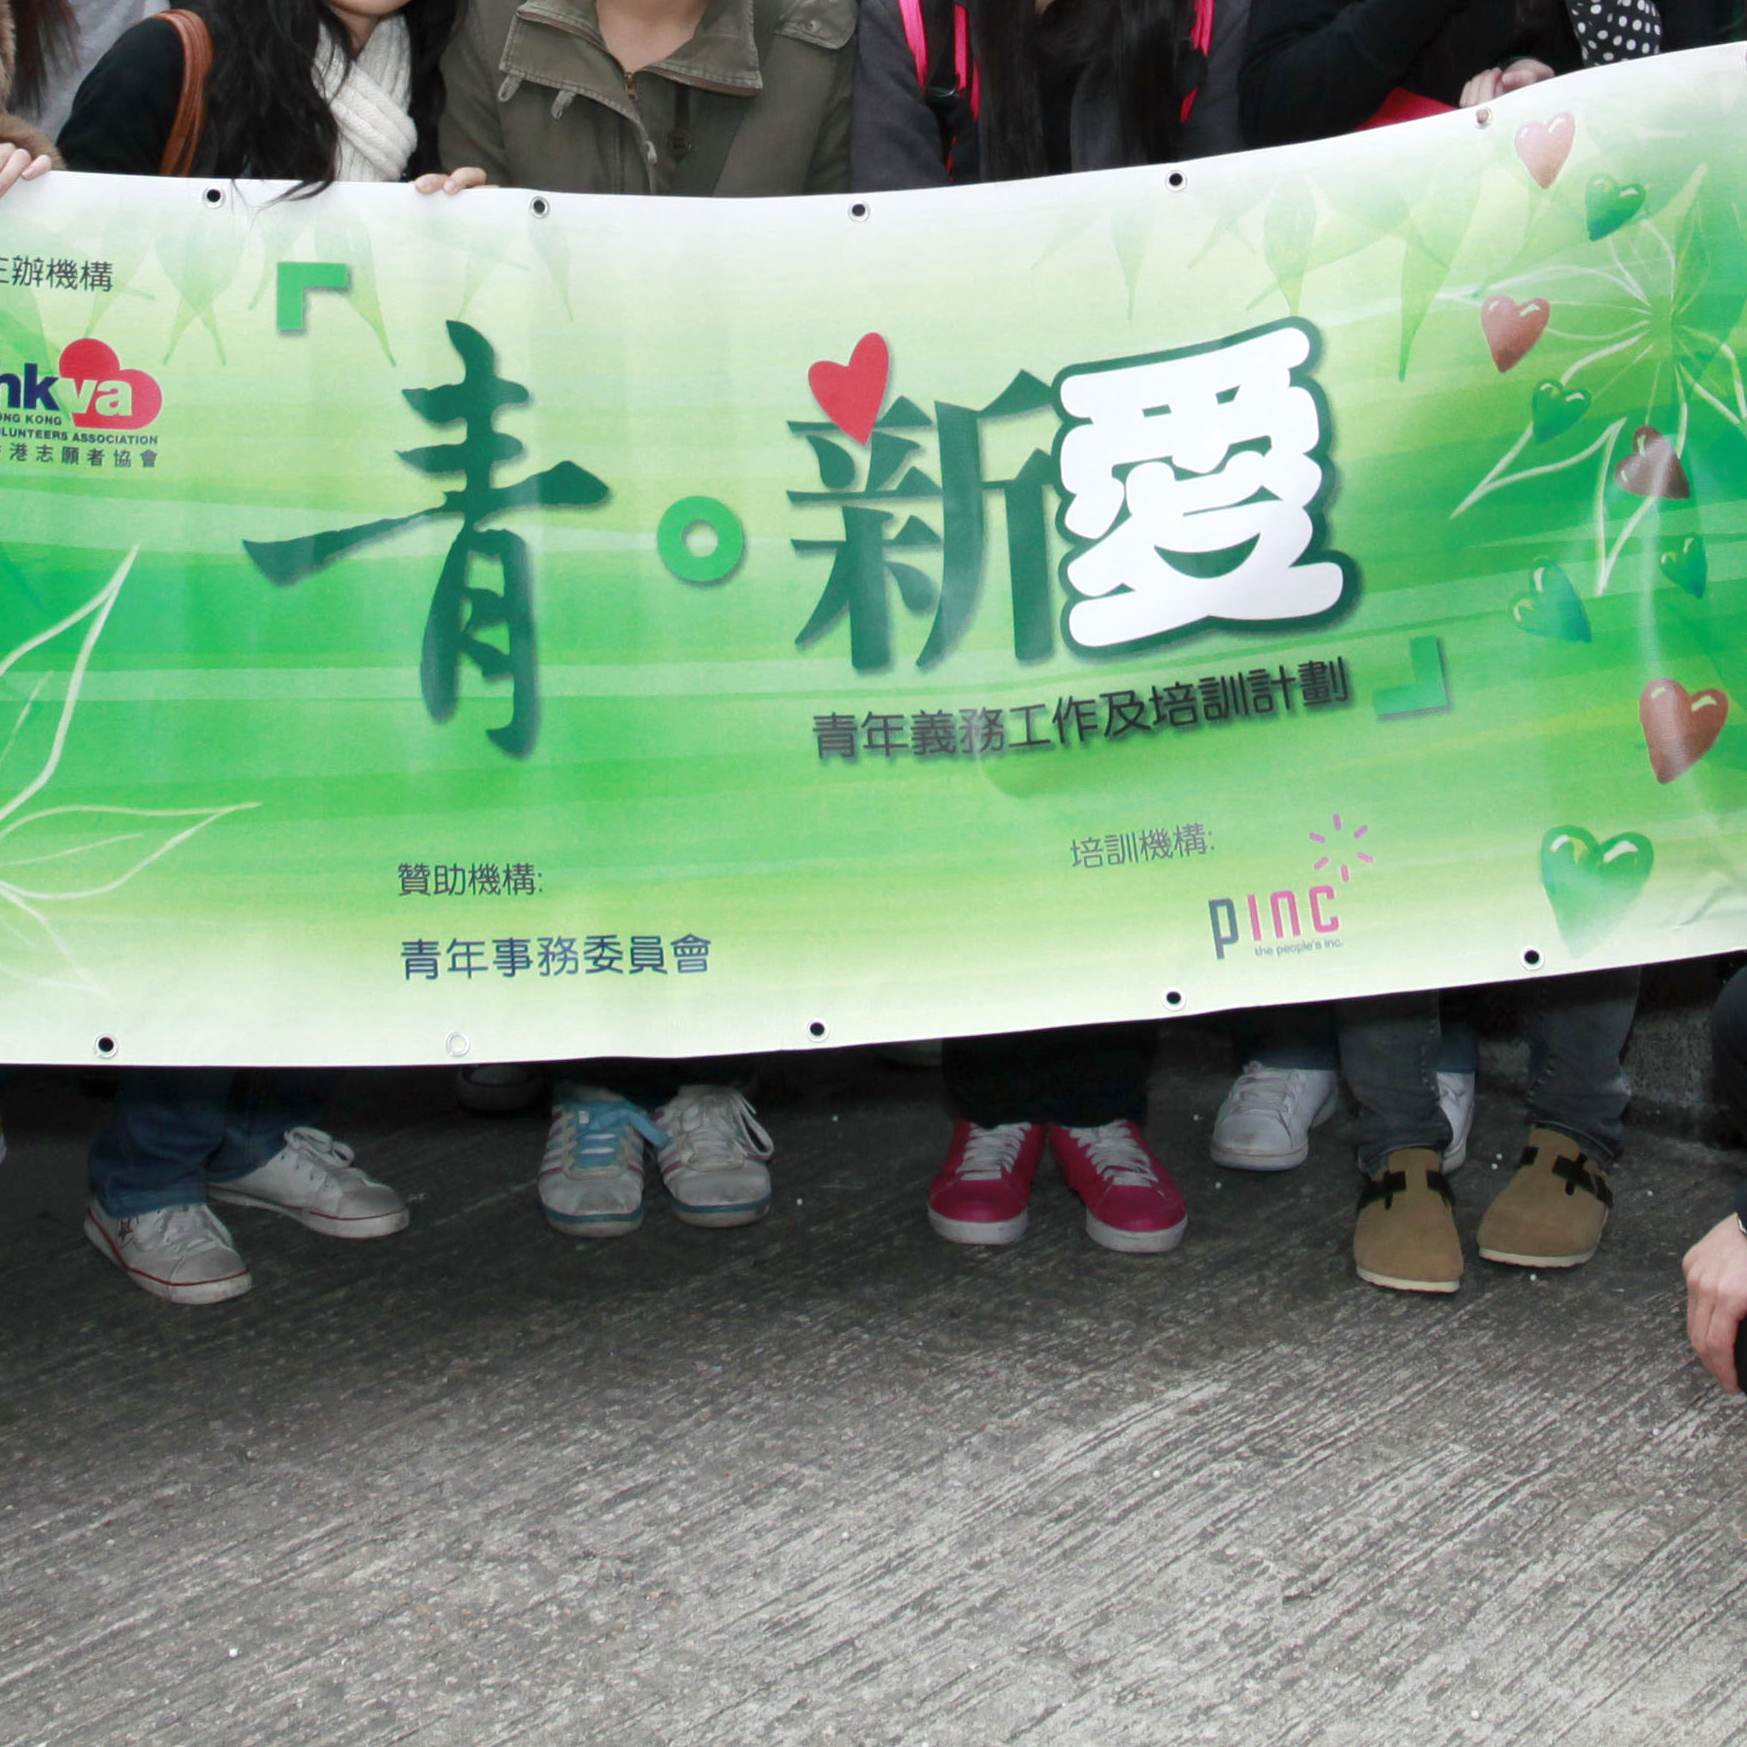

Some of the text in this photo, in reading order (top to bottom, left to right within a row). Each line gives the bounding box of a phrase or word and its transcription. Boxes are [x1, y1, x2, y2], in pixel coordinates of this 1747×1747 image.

[26, 414, 62, 426] KONG
[72, 432, 159, 445] ASSOCIATION
[812, 656, 1351, 759] 青年義務工作及培訓計劃
[401, 933, 712, 981] 青年事務委員會
